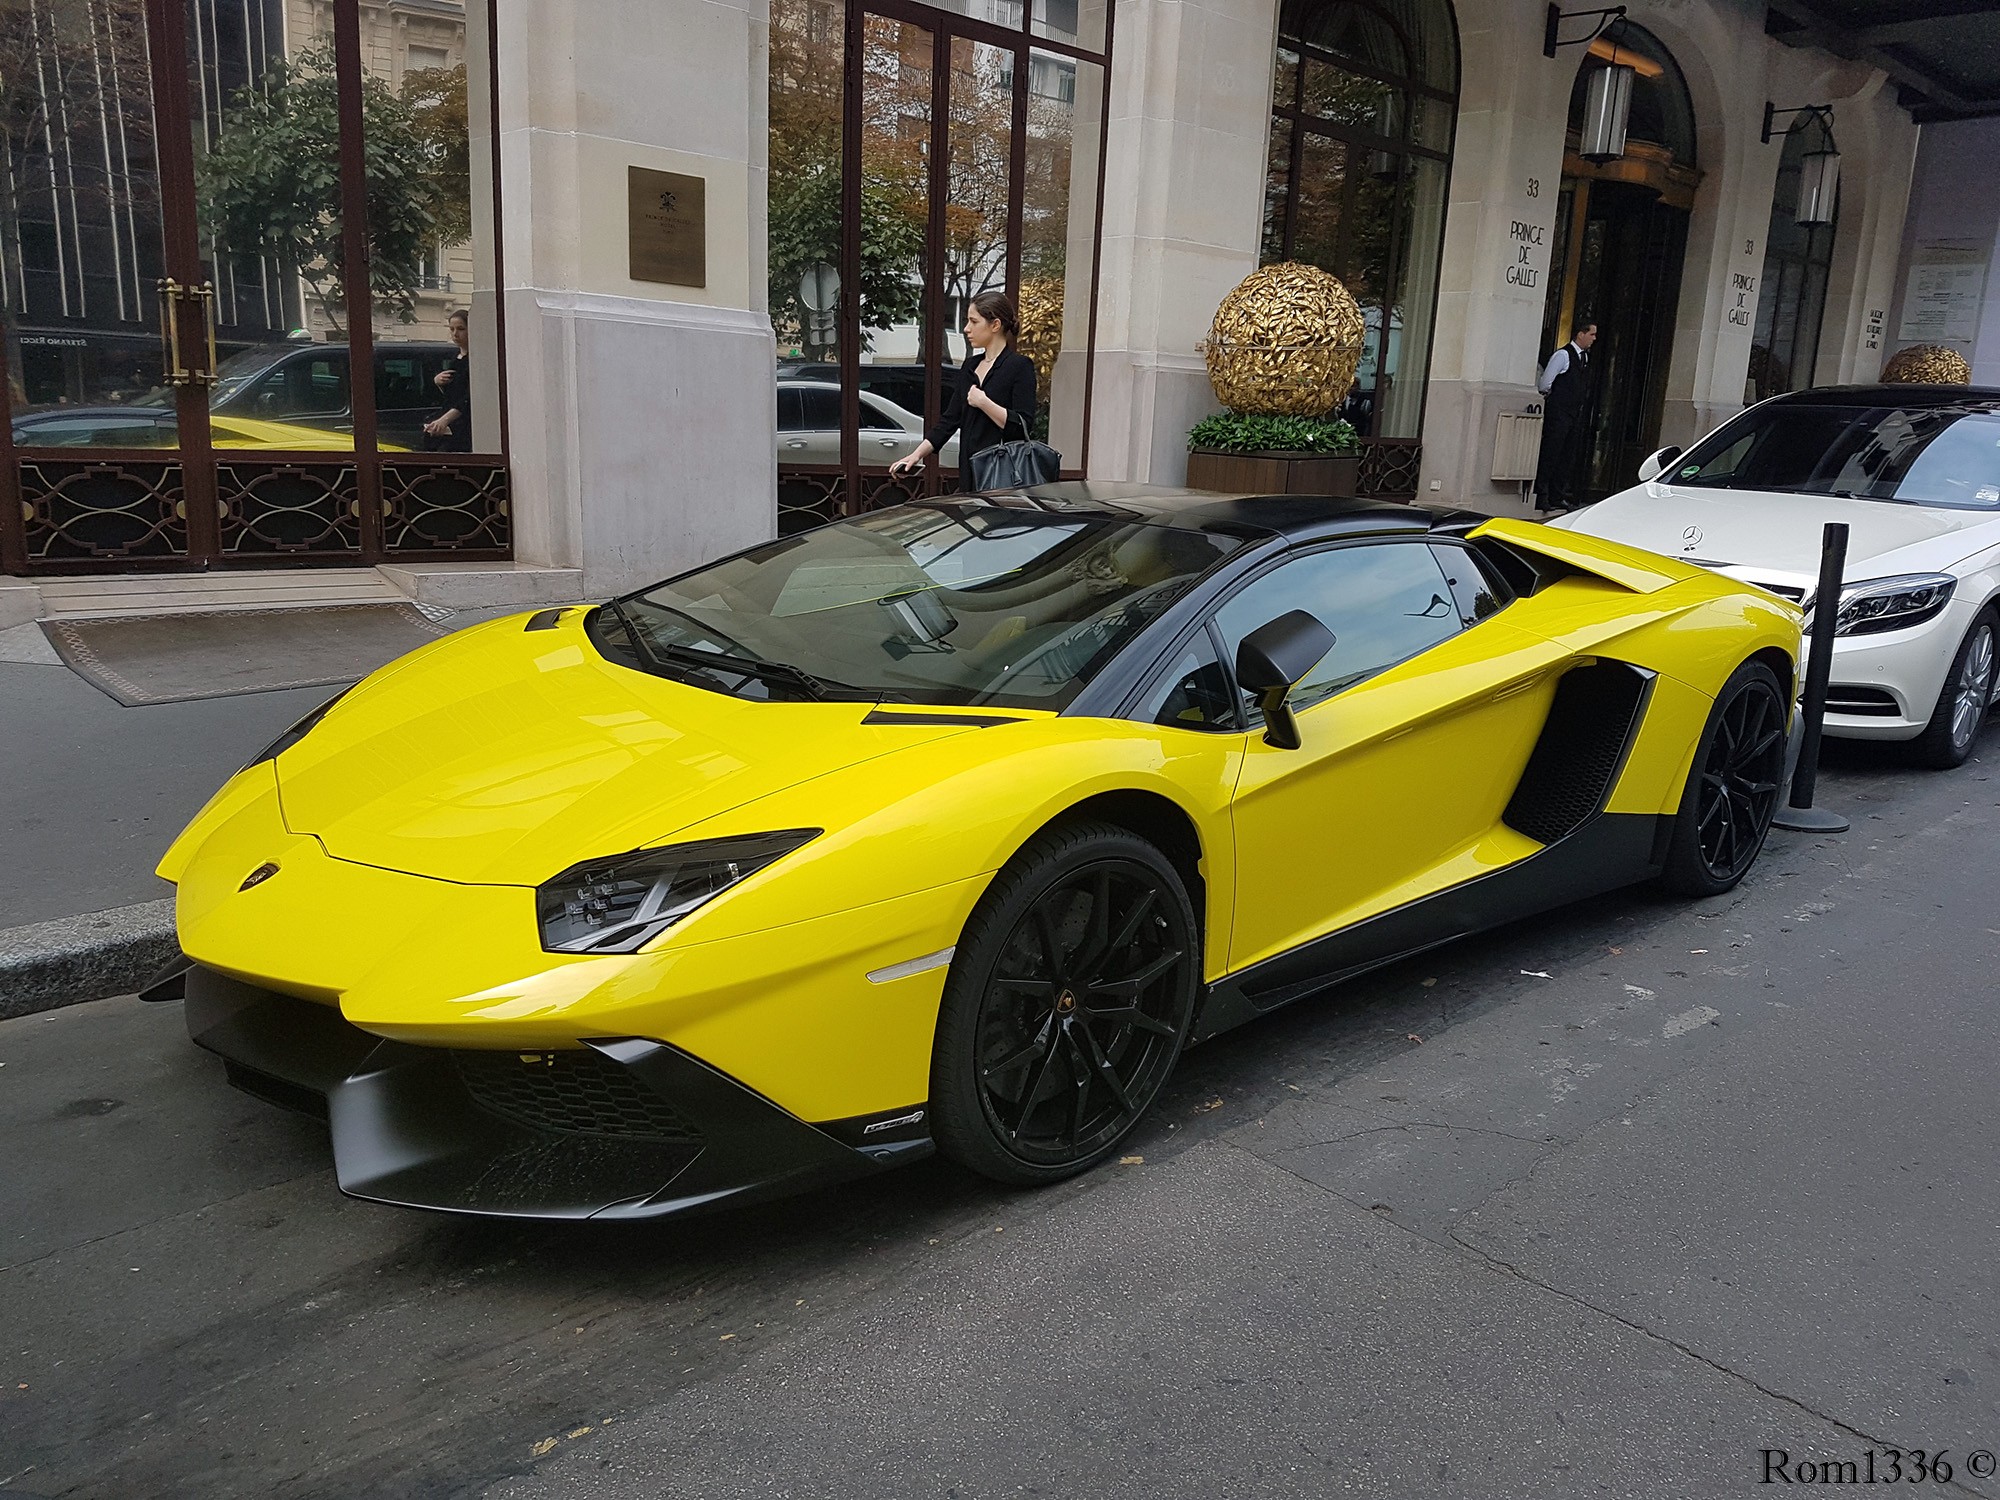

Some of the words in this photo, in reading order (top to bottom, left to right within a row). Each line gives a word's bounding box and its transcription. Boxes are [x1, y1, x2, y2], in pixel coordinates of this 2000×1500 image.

[1526, 178, 1540, 198] 33
[1509, 220, 1545, 246] PRINCE
[1518, 245, 1532, 265] DE
[1744, 239, 1754, 255] 33
[1506, 265, 1539, 288] GALLES
[1732, 272, 1756, 293] PRINCE
